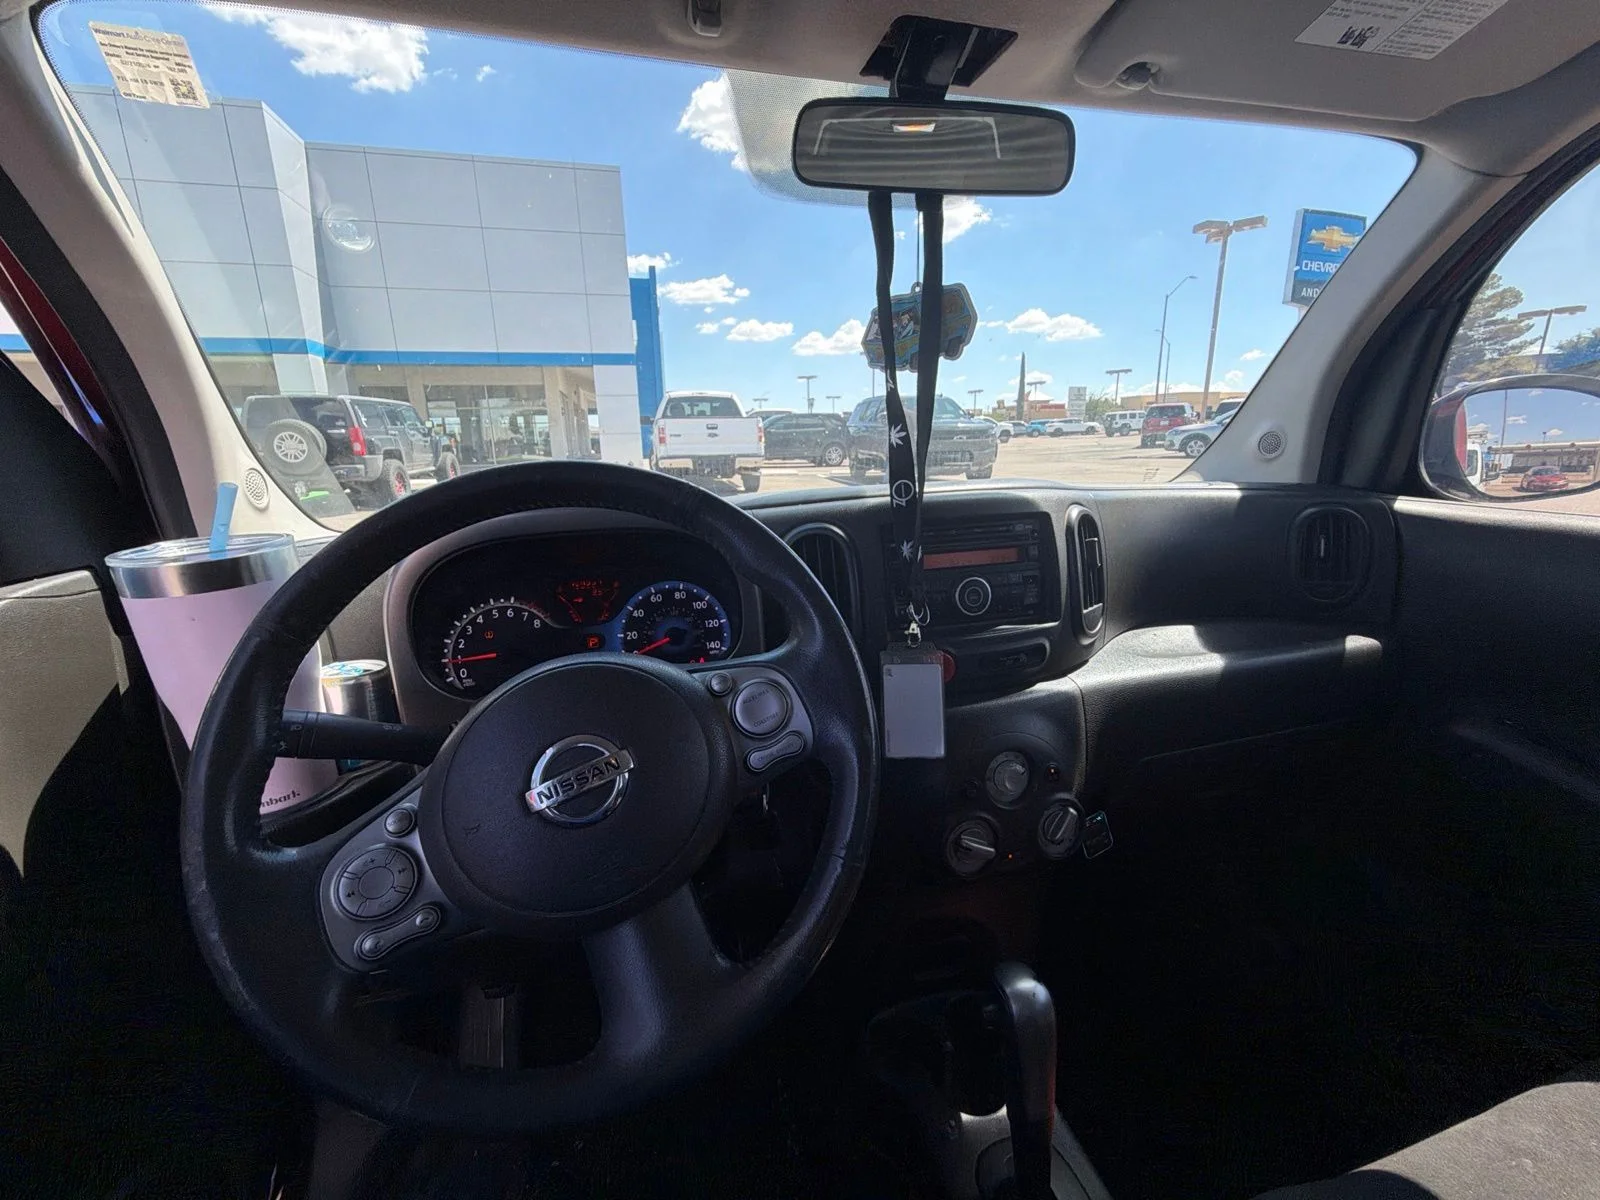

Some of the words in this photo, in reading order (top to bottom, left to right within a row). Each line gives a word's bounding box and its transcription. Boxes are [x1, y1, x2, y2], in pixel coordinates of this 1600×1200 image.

[650, 594, 662, 602] 60
[674, 590, 686, 600] 80
[692, 601, 707, 610] 100
[492, 610, 498, 618] 5
[506, 608, 514, 618] 6
[522, 612, 528, 621] 7
[632, 609, 644, 618] 40
[476, 614, 484, 624] 4
[534, 619, 540, 629] 8
[705, 620, 719, 628] 120
[466, 625, 472, 634] 3
[626, 631, 638, 640] 20
[458, 638, 464, 648] 2
[706, 640, 720, 650] 140
[460, 668, 467, 678] 0
[536, 756, 621, 805] NISSAN
